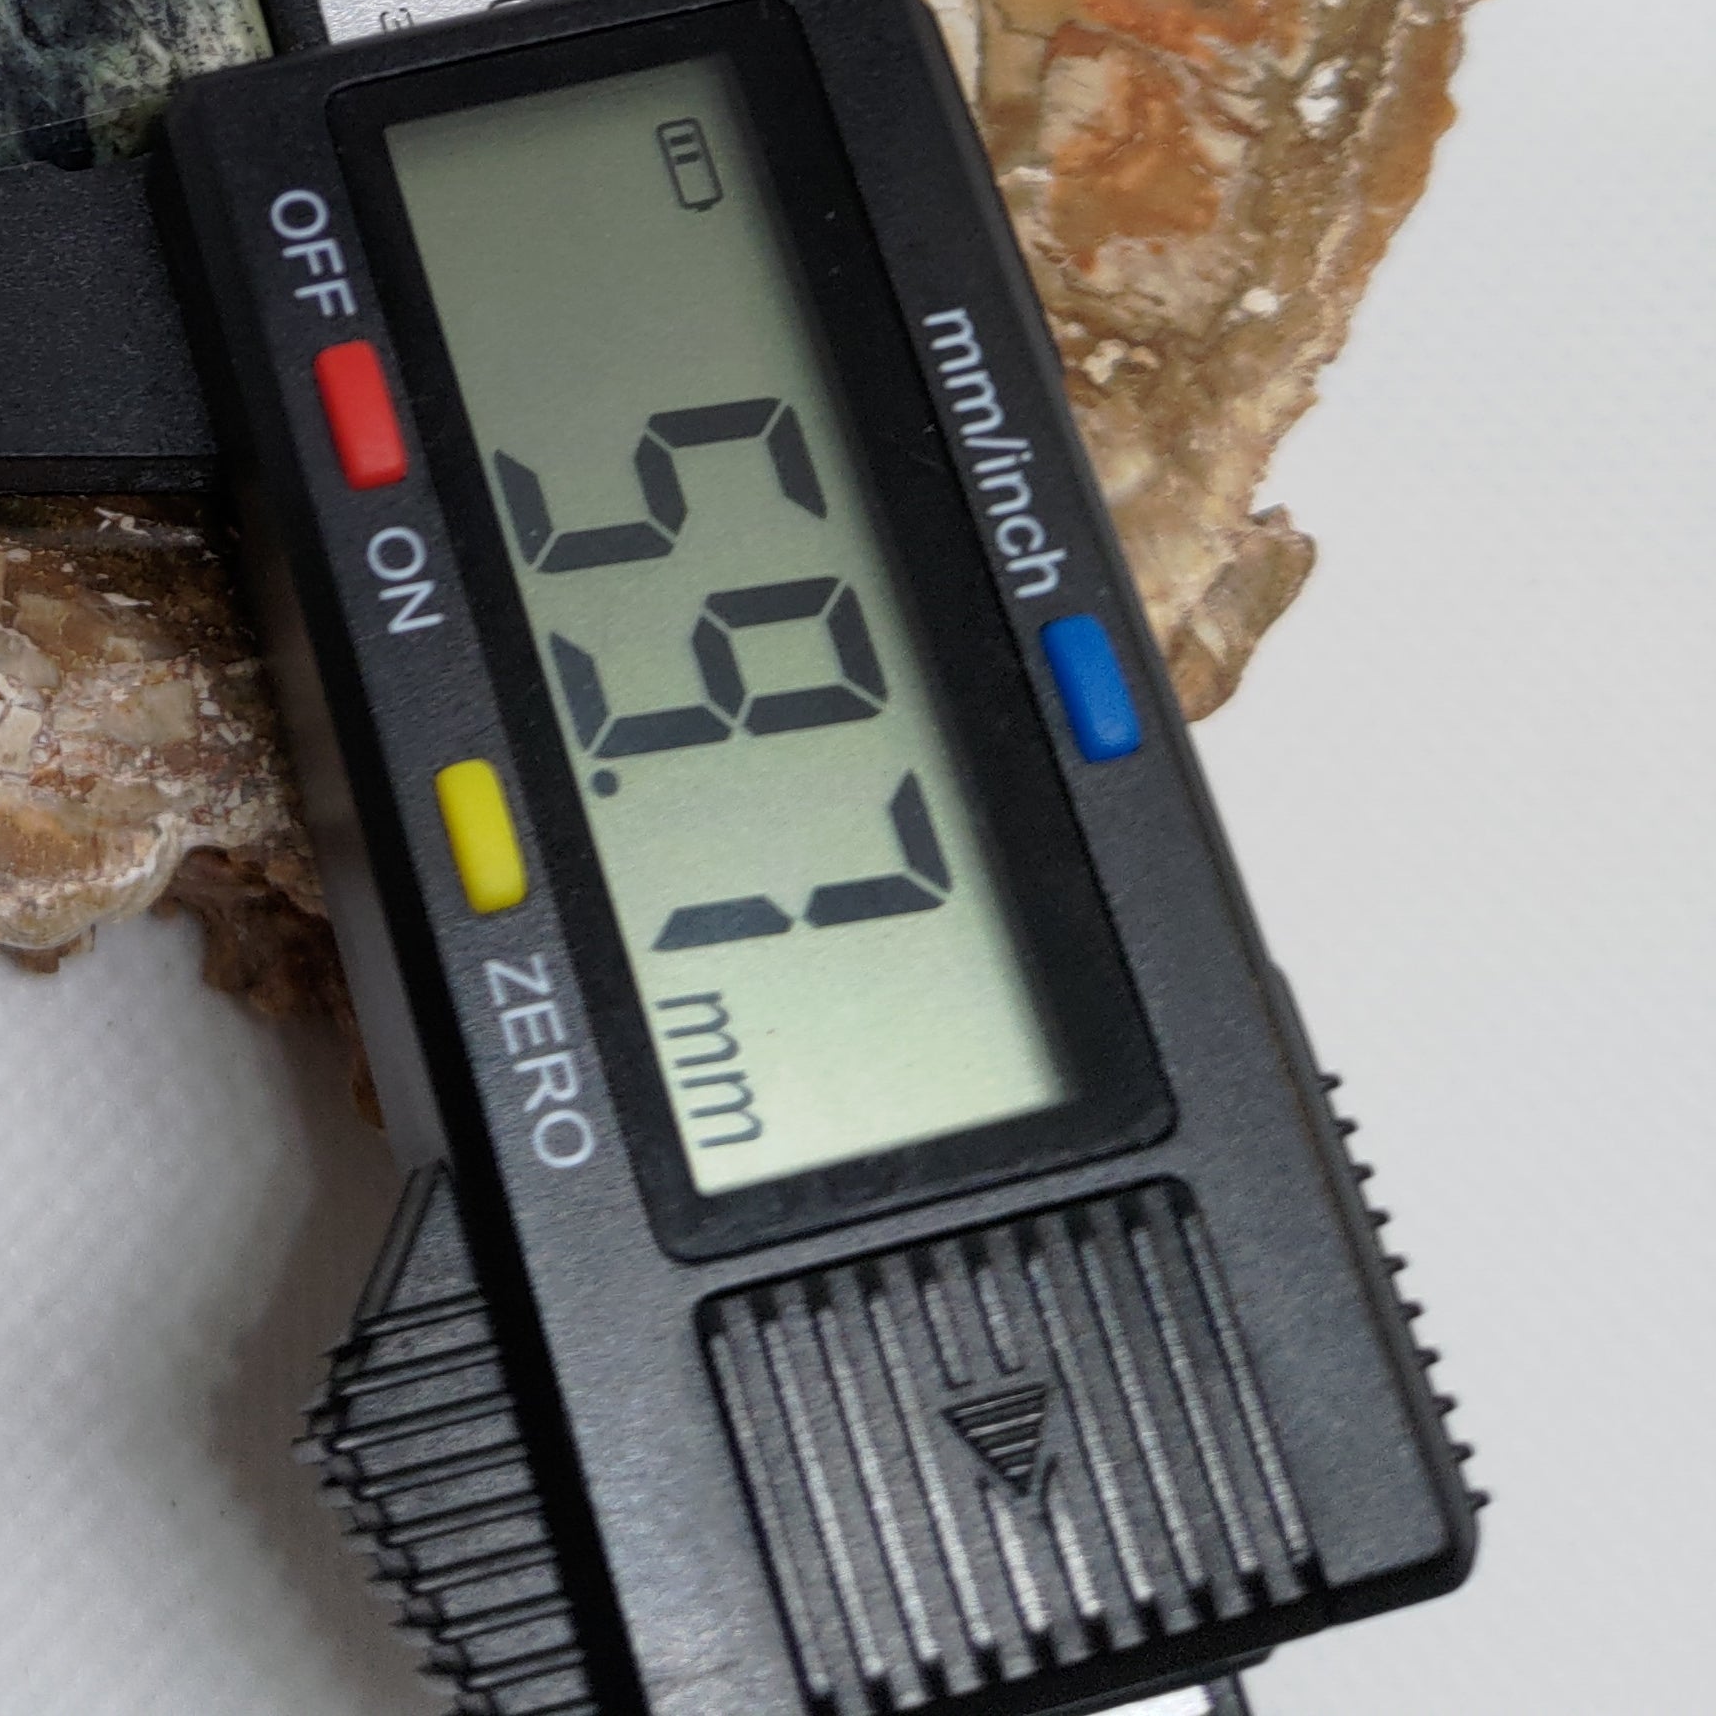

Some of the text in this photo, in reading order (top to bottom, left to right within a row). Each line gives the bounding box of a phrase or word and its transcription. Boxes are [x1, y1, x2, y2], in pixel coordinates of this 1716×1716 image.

[268, 188, 360, 321] OFF
[921, 305, 1071, 601] mm/inch
[365, 525, 445, 637] ON
[492, 396, 953, 1151] 59.7 mm
[484, 953, 597, 1171] ZERO
